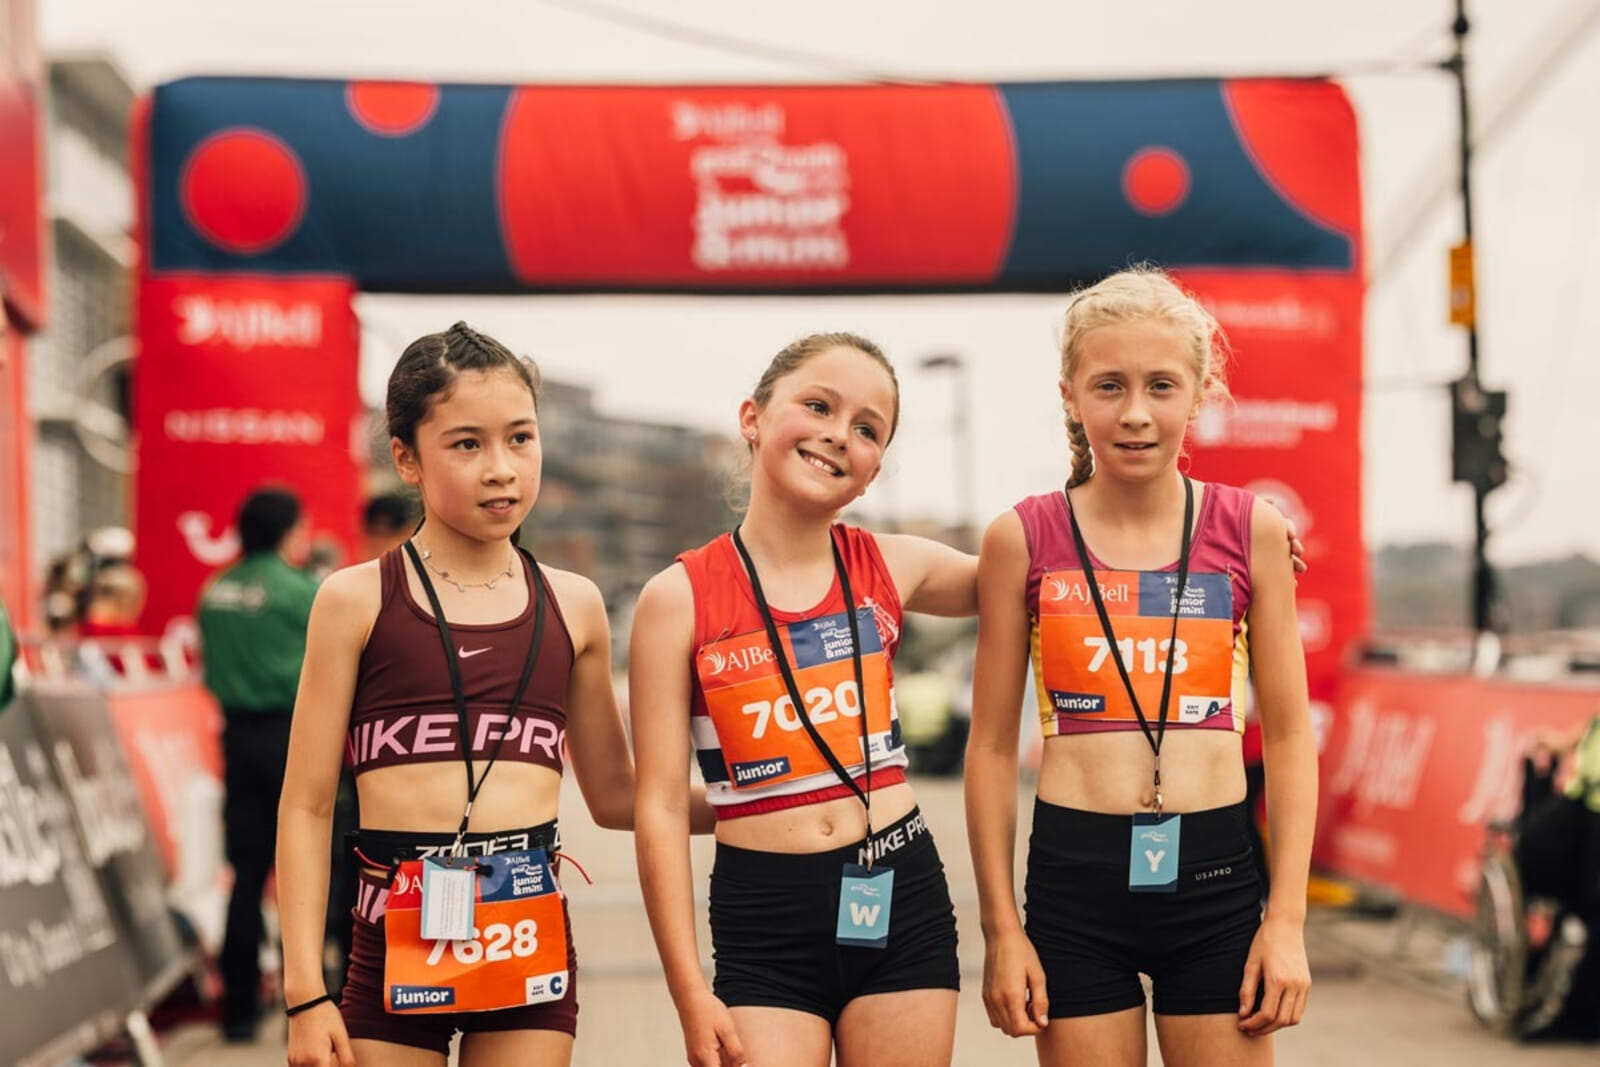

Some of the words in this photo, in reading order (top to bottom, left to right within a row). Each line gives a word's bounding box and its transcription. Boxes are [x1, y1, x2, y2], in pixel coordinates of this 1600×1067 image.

[1084, 636, 1188, 675] 7113
[742, 680, 862, 739] 7020
[1054, 694, 1100, 709] junior
[1205, 701, 1220, 718] A
[736, 760, 785, 782] junior
[1144, 850, 1166, 873] Y
[850, 902, 881, 927] W
[426, 918, 539, 966] 7628
[395, 988, 449, 1005] junior
[550, 976, 563, 995] C
